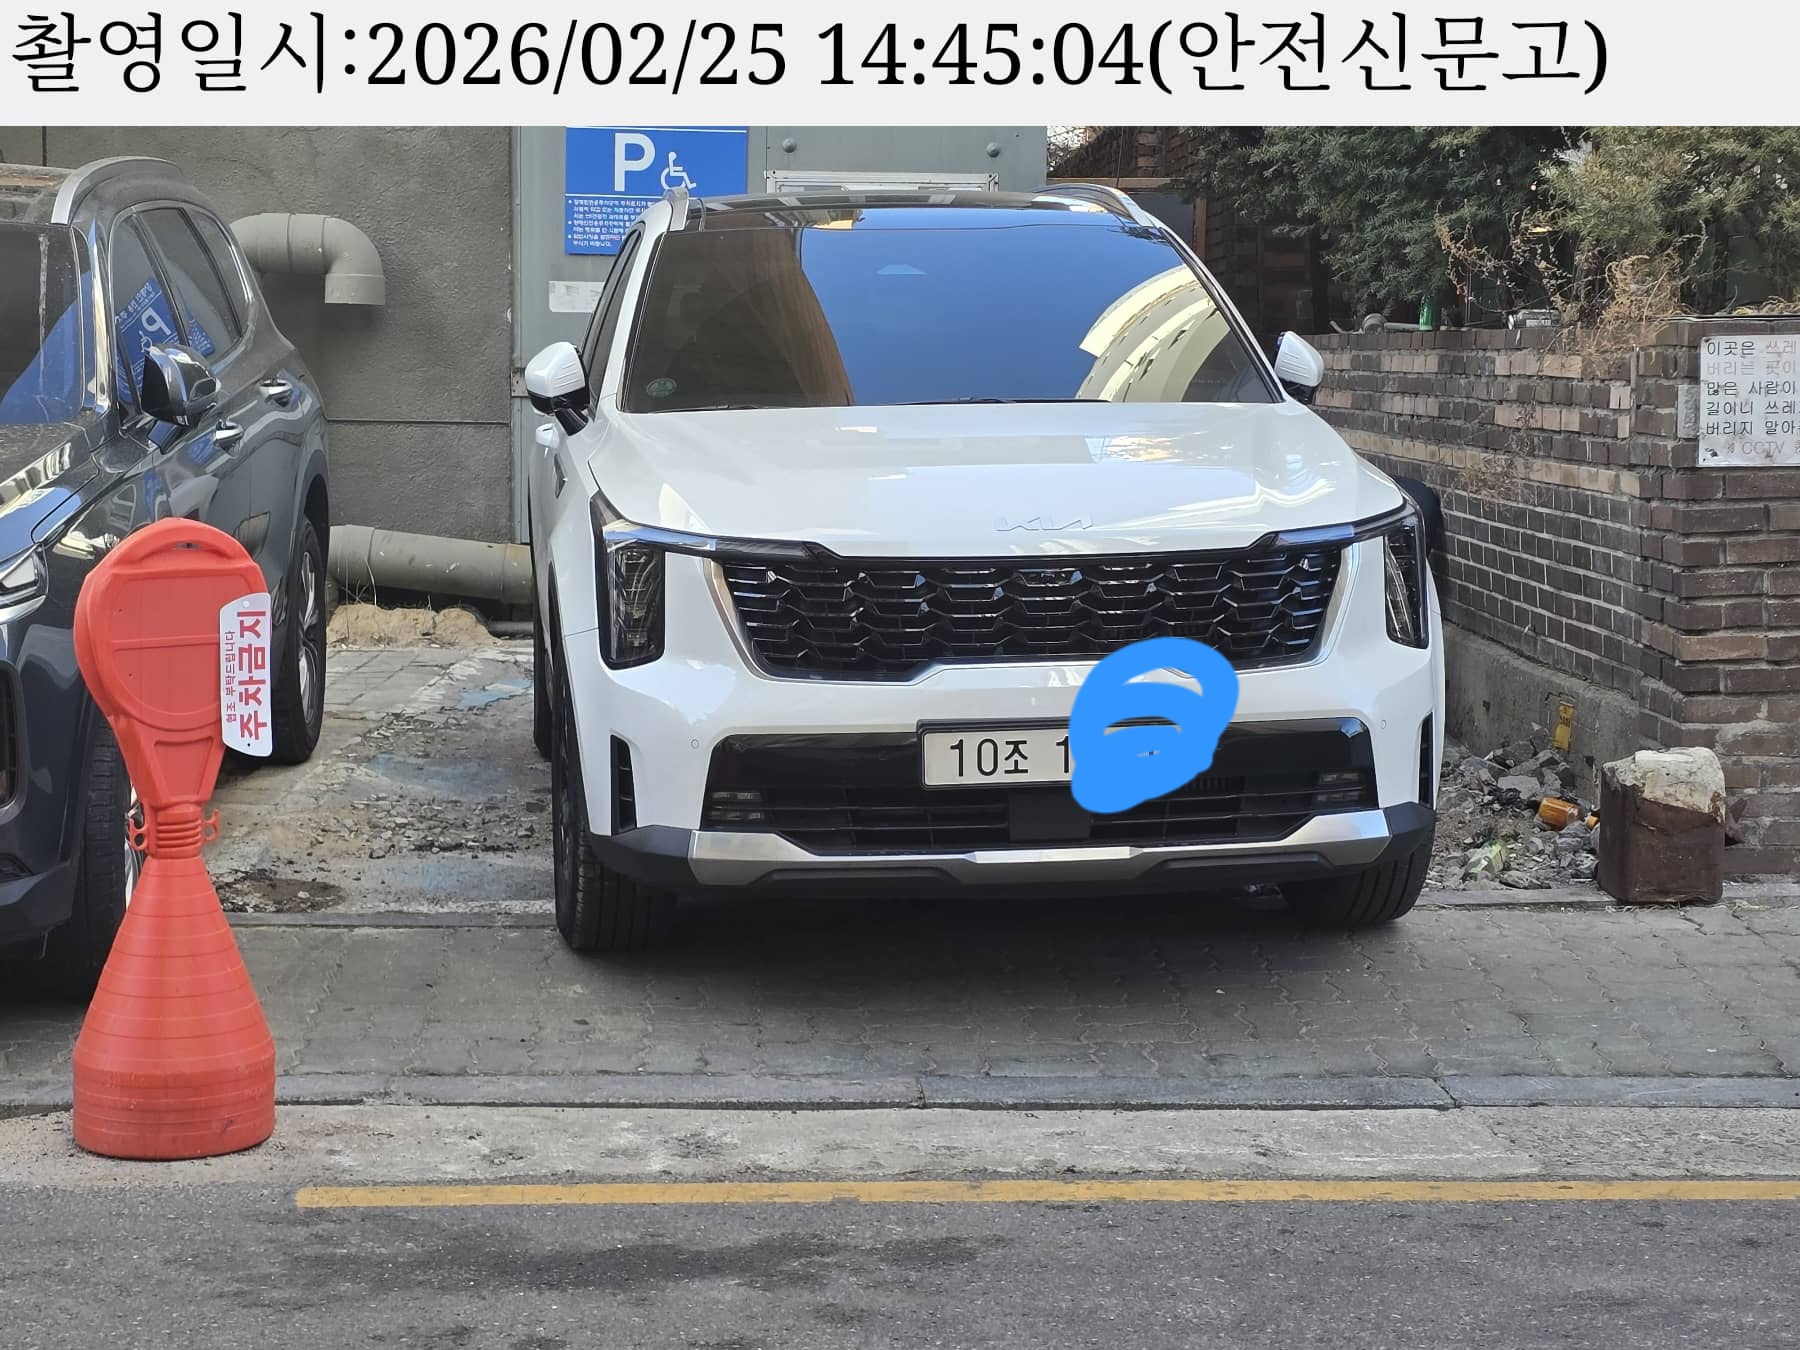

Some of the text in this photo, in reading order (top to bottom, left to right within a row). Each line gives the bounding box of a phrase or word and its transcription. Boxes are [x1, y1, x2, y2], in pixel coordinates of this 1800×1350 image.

[614, 132, 656, 191] P
[1707, 340, 1798, 356] 이곳은 쓰레
[1707, 360, 1755, 376] 버리는
[1707, 380, 1796, 396] 많은 사람이
[1706, 400, 1800, 416] 길이니 쓰레
[1706, 420, 1800, 436] 버리지 말아
[1741, 441, 1785, 455] CCTV
[224, 631, 237, 723] 협조 부탁드립니다
[236, 611, 268, 741] 주차금지
[950, 738, 1029, 777] 10조
